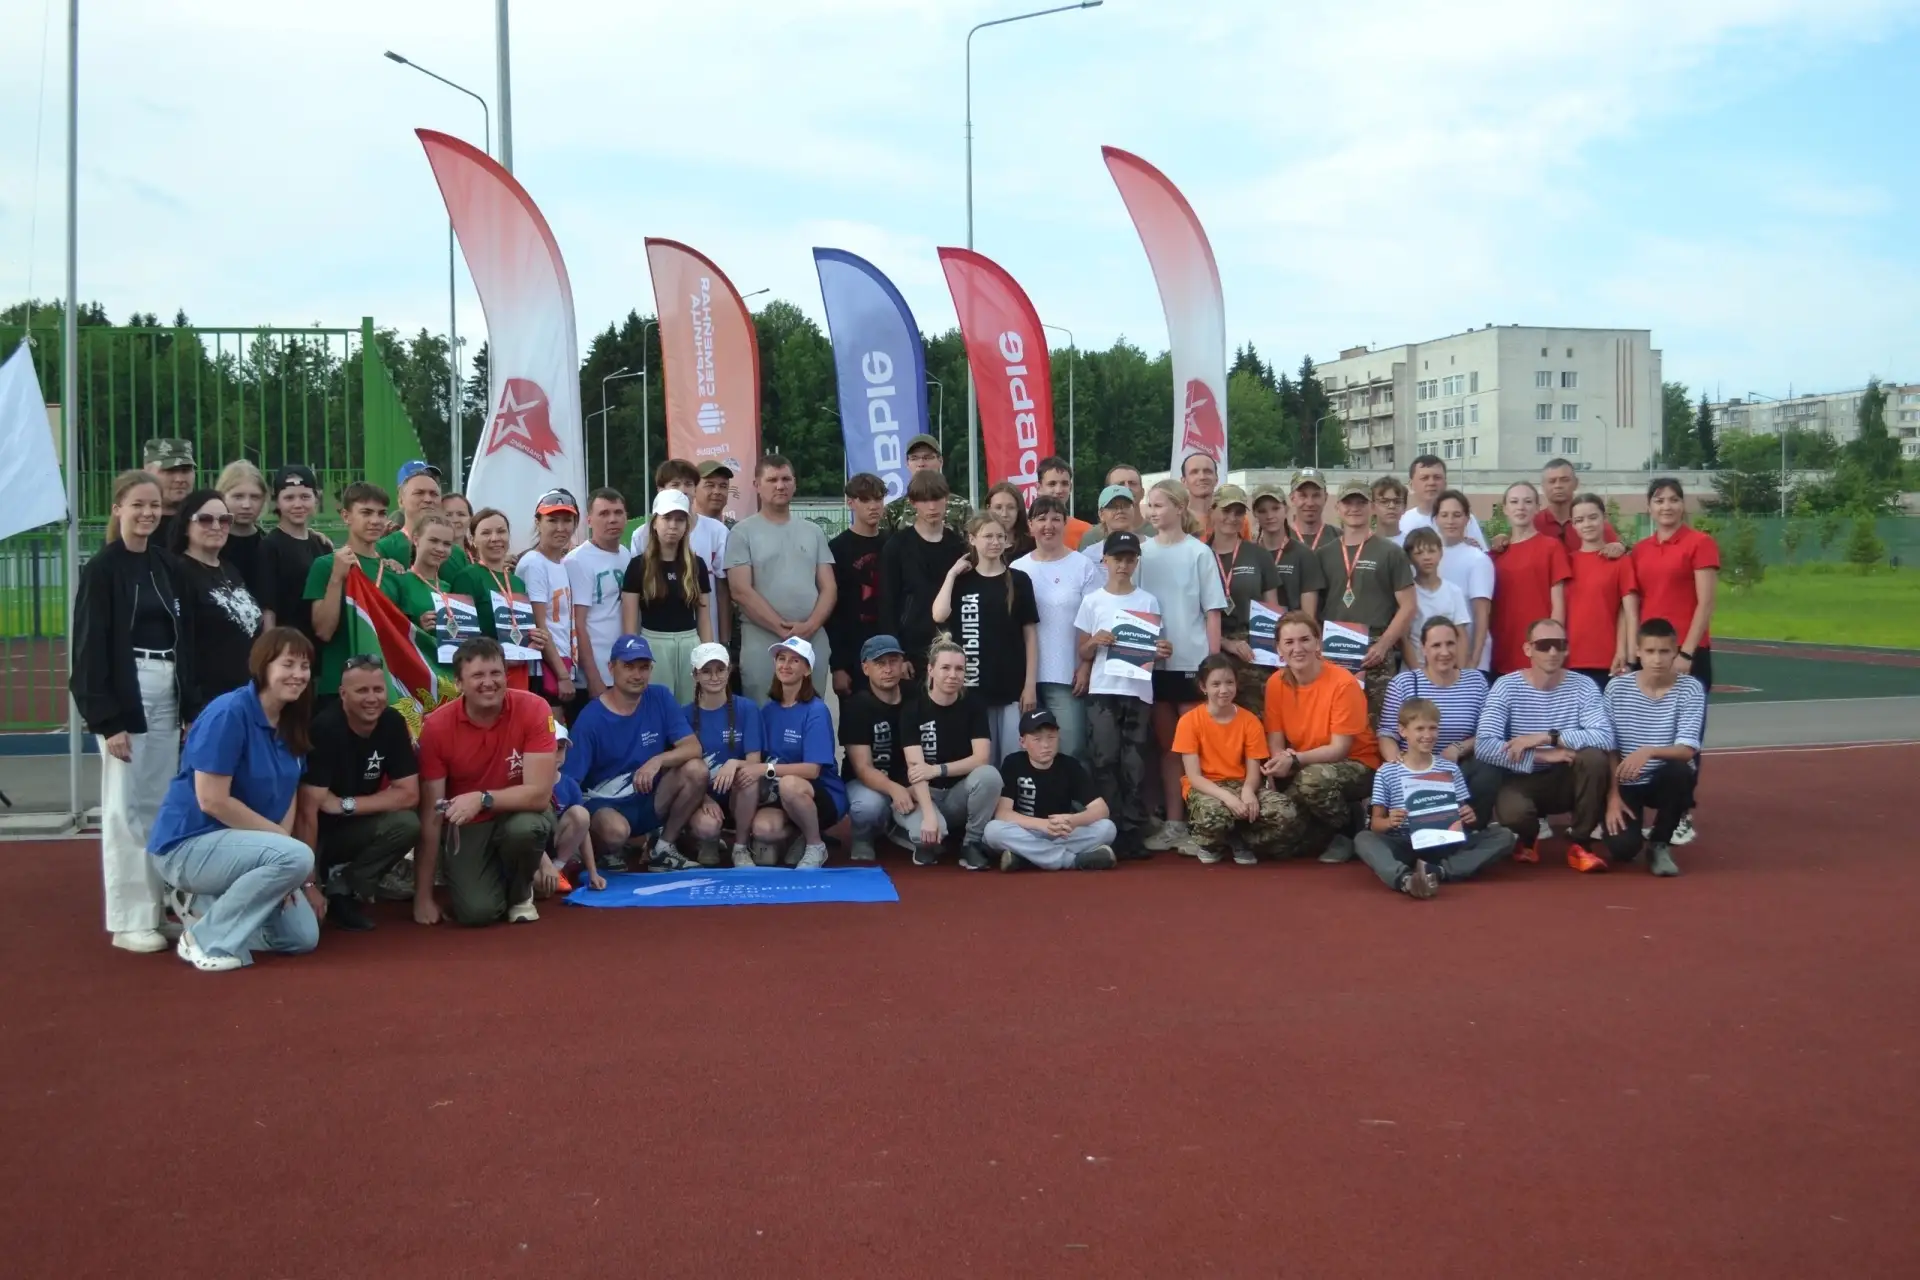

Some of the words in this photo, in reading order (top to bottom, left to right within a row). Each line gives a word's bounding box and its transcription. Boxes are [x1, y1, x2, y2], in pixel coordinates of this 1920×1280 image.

[961, 593, 980, 687] КОСТЫЛЕВА
[1118, 630, 1152, 640] ДИПЛОМ
[1413, 793, 1449, 805] ДИПЛОМ
